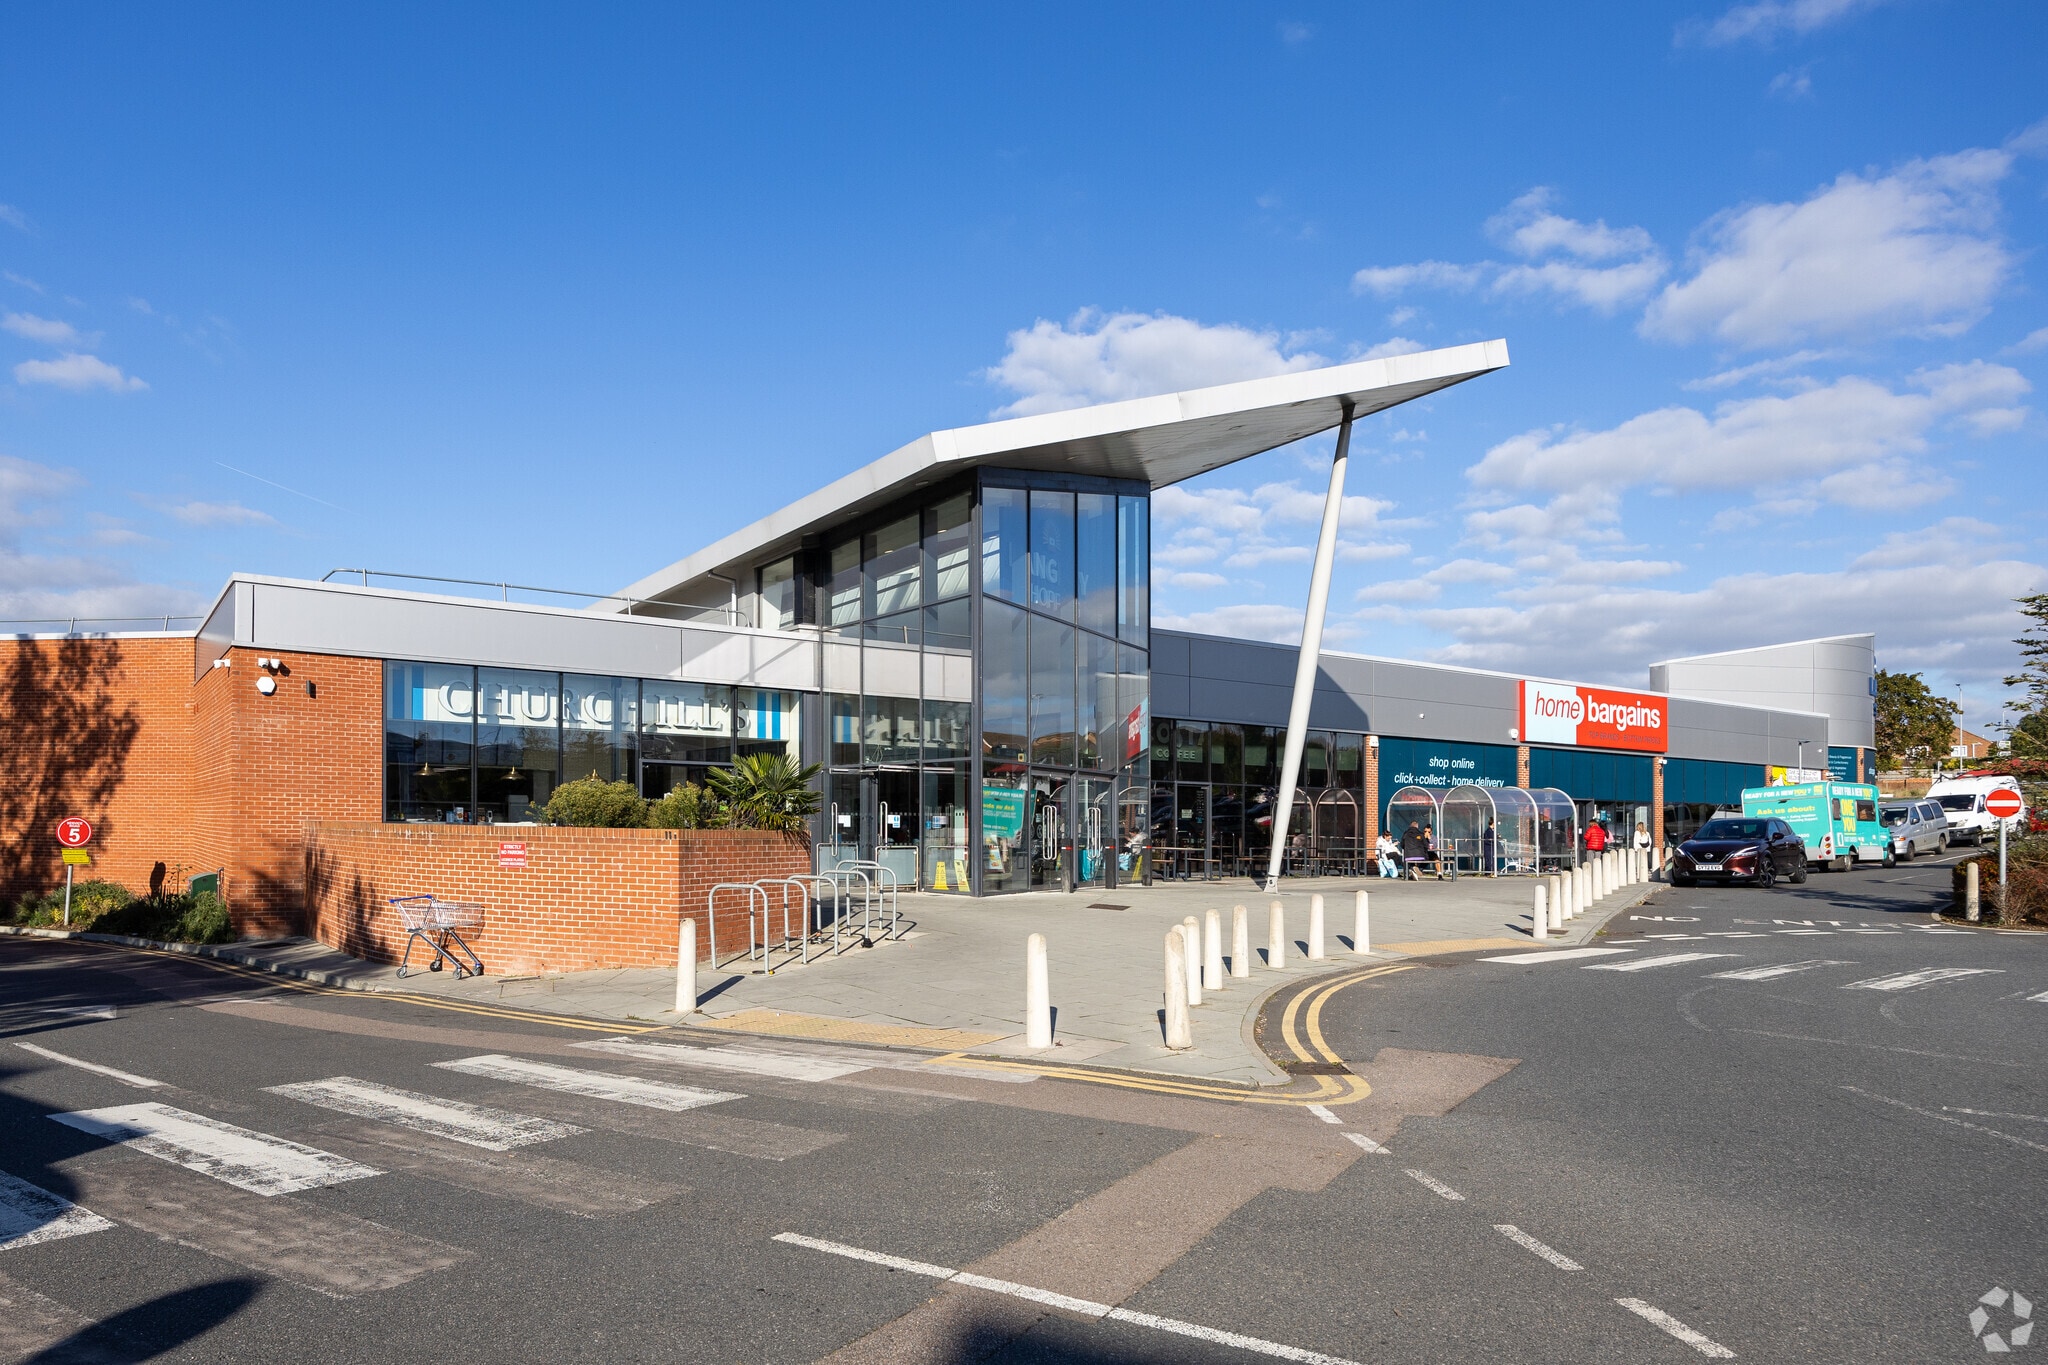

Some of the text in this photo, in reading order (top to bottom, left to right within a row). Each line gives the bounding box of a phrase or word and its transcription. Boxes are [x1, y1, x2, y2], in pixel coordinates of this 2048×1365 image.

[1535, 691, 1661, 732] home bargains
[1156, 748, 1196, 759] COFEE
[1429, 756, 1475, 770] shop online
[1394, 772, 1446, 786] click+collect
[1451, 775, 1474, 786] home
[1475, 777, 1504, 788] delivery
[1757, 808, 1773, 816] Ask
[1787, 805, 1816, 814] about:
[1840, 799, 1855, 816] ONE
[1843, 817, 1856, 832] YOU
[68, 828, 80, 843] 5
